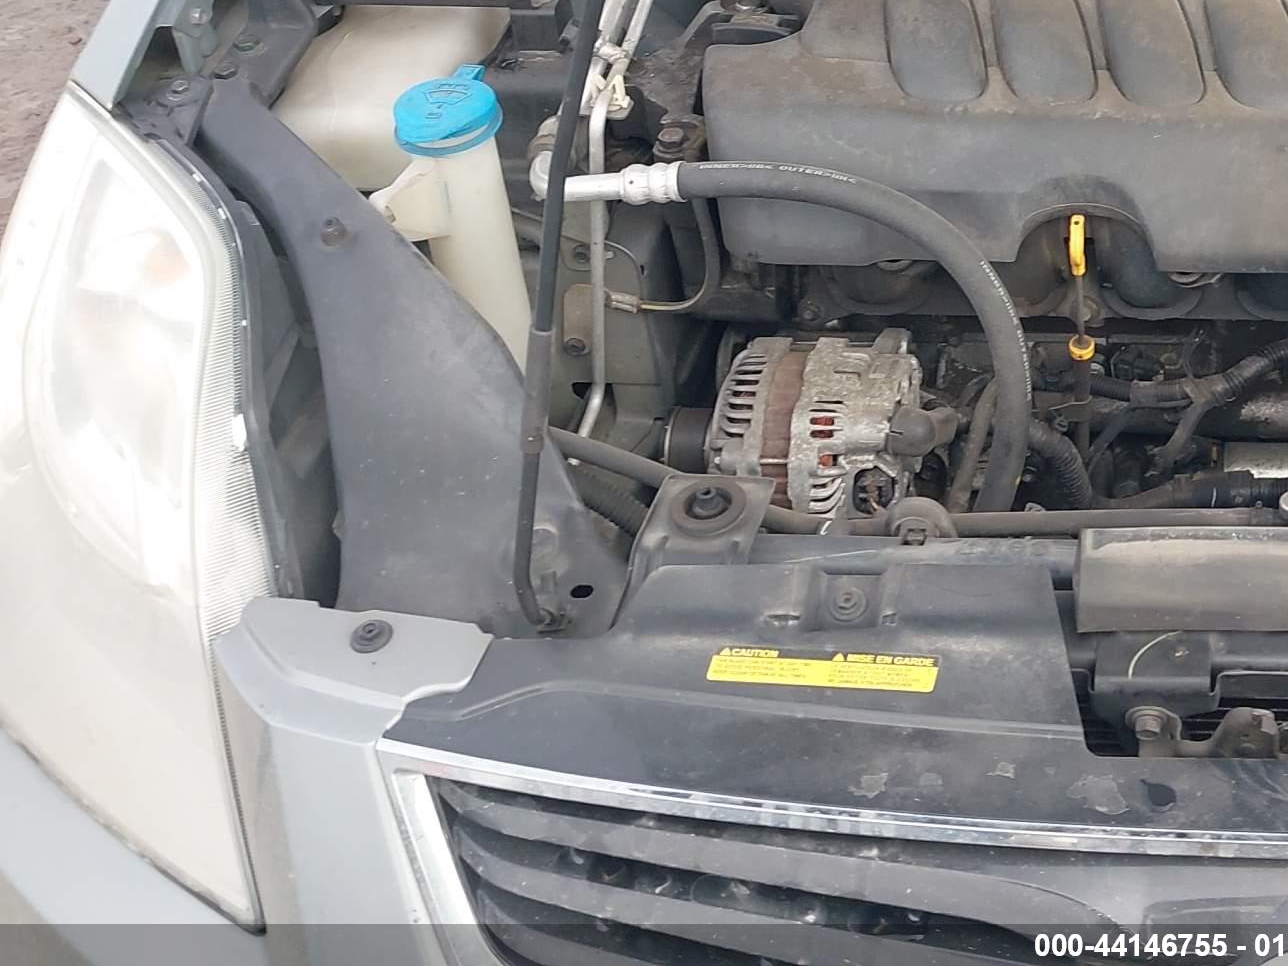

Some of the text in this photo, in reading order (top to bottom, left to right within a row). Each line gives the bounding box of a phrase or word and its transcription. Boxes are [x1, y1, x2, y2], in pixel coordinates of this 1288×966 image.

[731, 648, 779, 659] CAUTION
[876, 655, 892, 665] EN
[893, 656, 935, 667] GARDE
